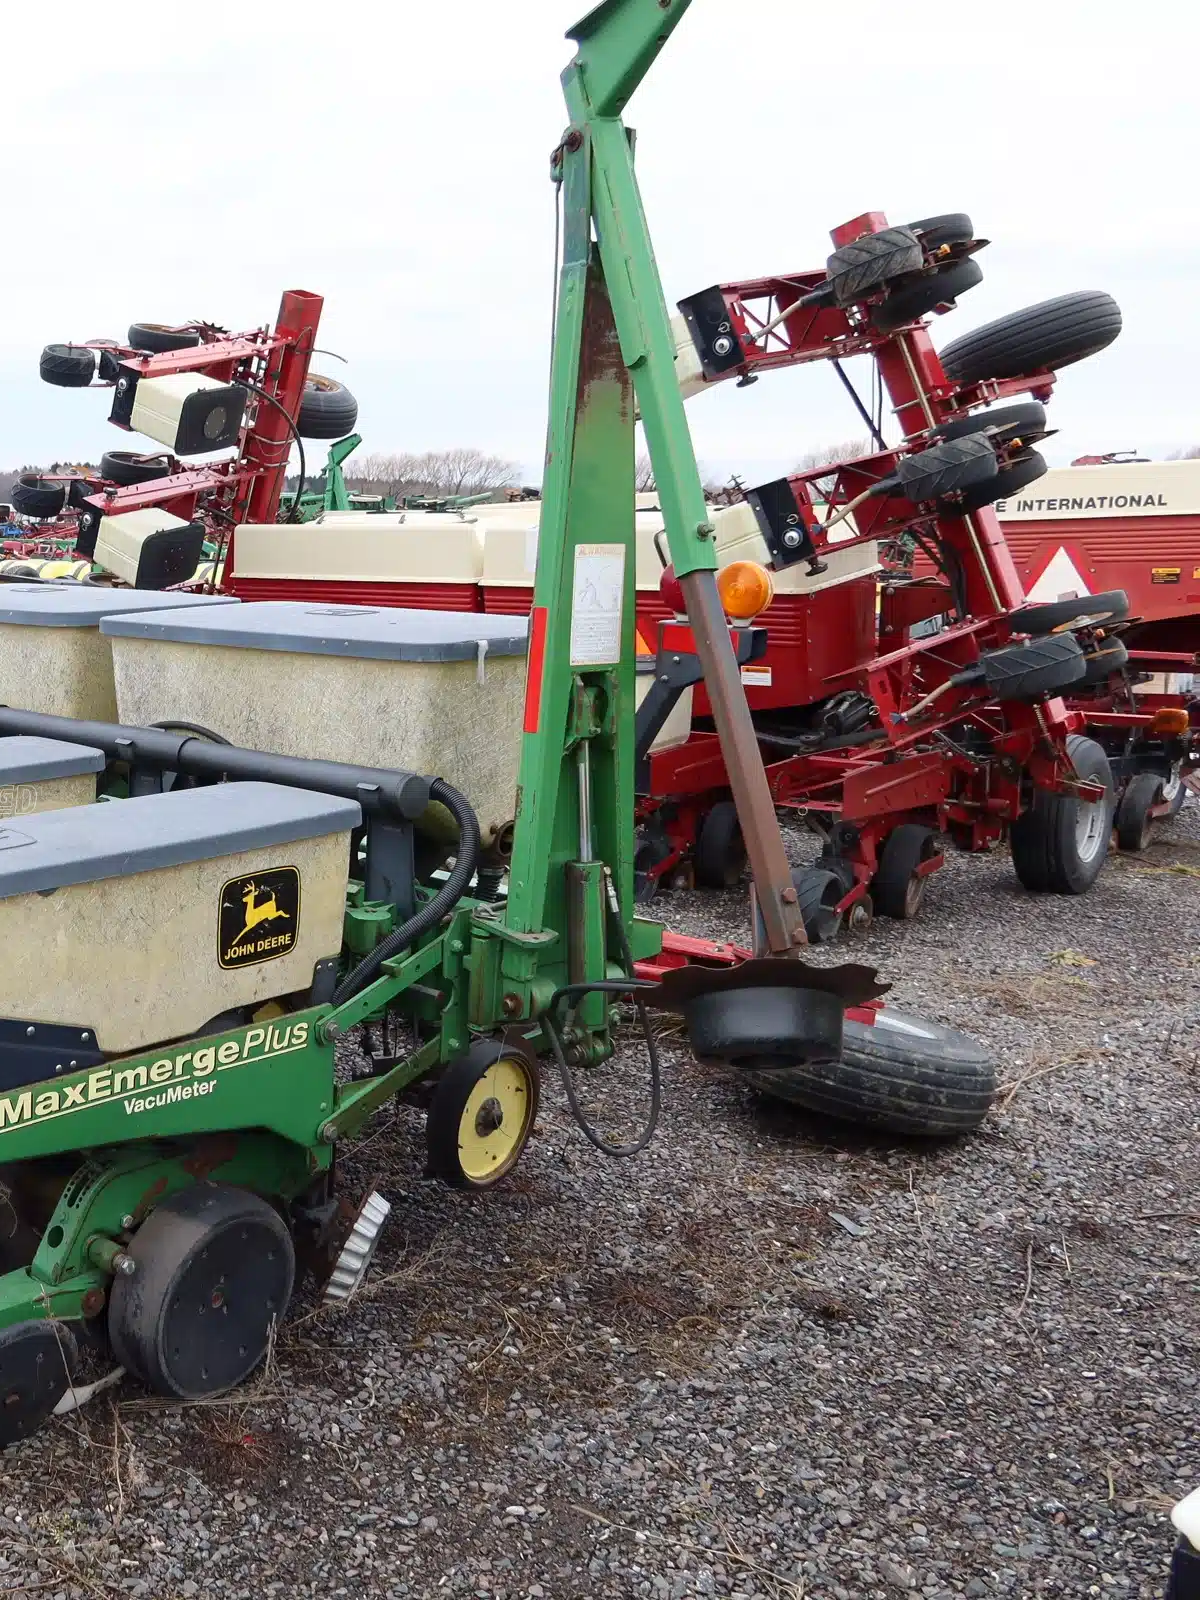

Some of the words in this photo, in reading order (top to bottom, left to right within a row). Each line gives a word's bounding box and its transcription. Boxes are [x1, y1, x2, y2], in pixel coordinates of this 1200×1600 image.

[1016, 494, 1168, 512] INTERNATIONAL
[224, 943, 255, 960] JOHN
[257, 933, 292, 952] DEERE
[123, 1078, 218, 1115] VacuMeter
